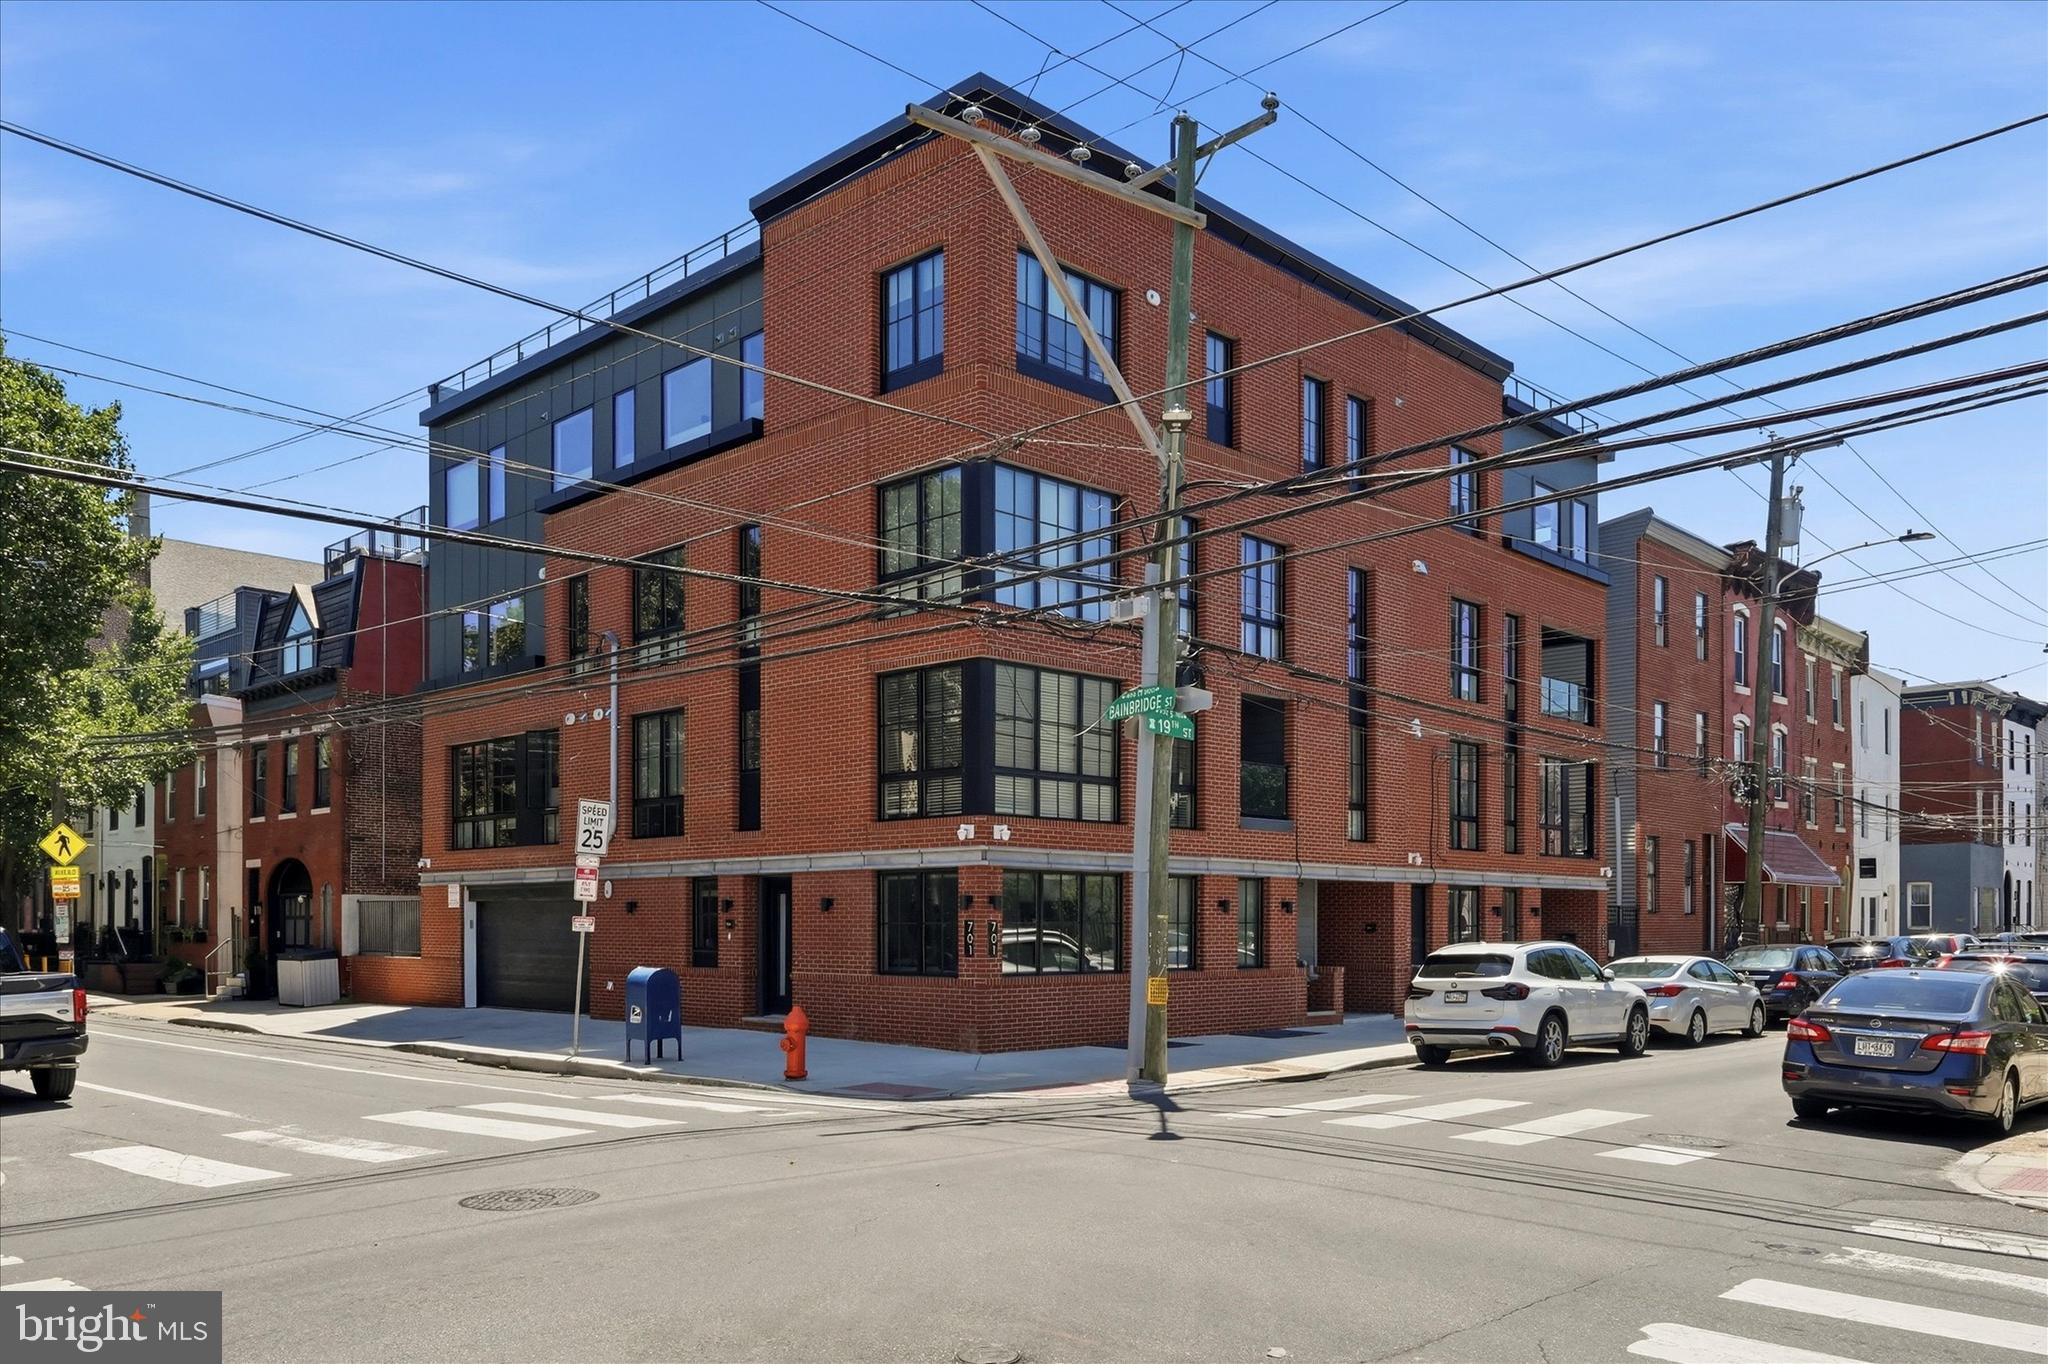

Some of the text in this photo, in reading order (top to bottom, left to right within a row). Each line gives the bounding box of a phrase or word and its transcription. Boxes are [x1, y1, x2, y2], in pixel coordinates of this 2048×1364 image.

[1109, 694, 1162, 719] BAINBRIDGE
[1164, 696, 1173, 707] ST
[582, 805, 607, 816] SPEED
[583, 816, 604, 827] LIMIT
[581, 829, 603, 849] 25
